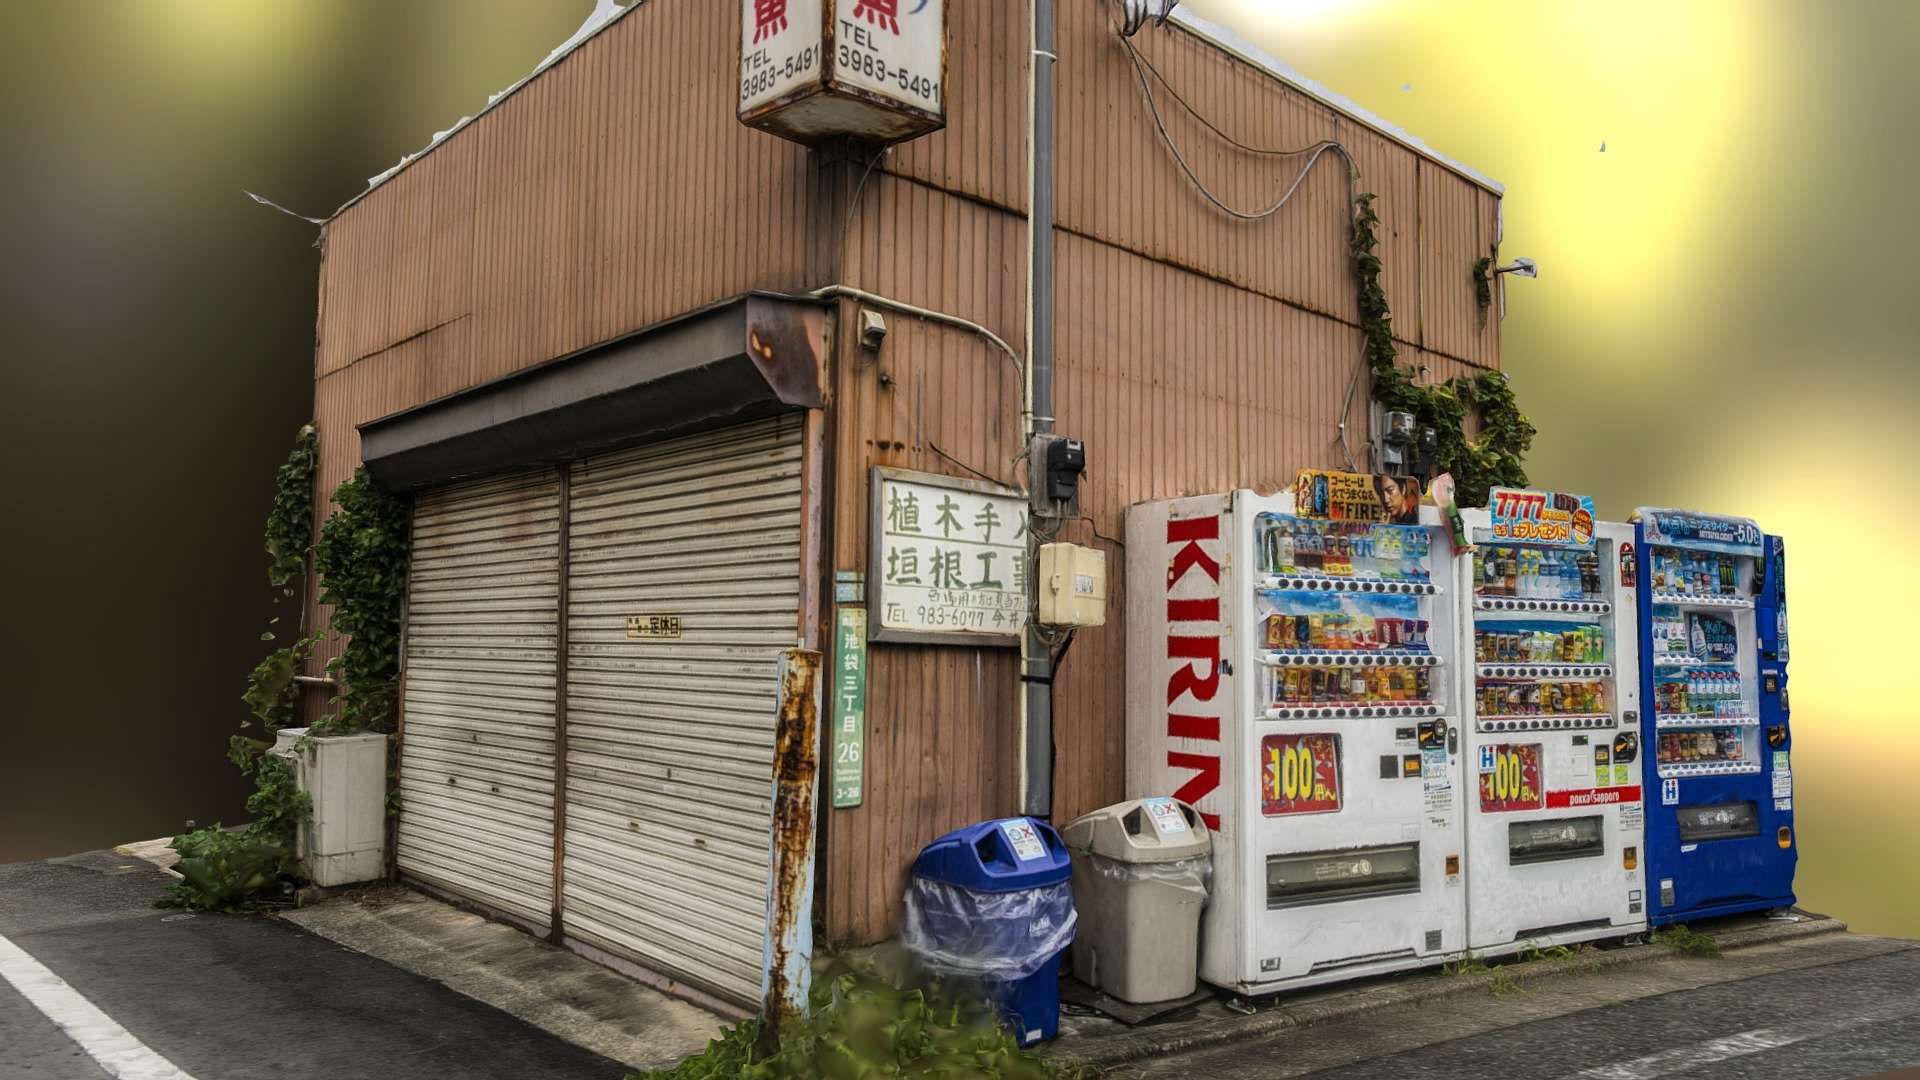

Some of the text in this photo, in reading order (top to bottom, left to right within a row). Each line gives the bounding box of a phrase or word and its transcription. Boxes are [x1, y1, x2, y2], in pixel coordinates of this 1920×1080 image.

[838, 19, 879, 52] TEL
[742, 43, 819, 100] 3983-5491
[744, 47, 771, 74] TEL
[838, 45, 939, 103] 3983-5491
[1331, 476, 1365, 488] コーヒーは
[1495, 491, 1547, 519] 7777
[650, 616, 679, 634] 定休日
[886, 602, 909, 623] TEL
[917, 605, 984, 627] 983-6077
[1167, 514, 1220, 832] KIRIN
[837, 742, 860, 763] 26
